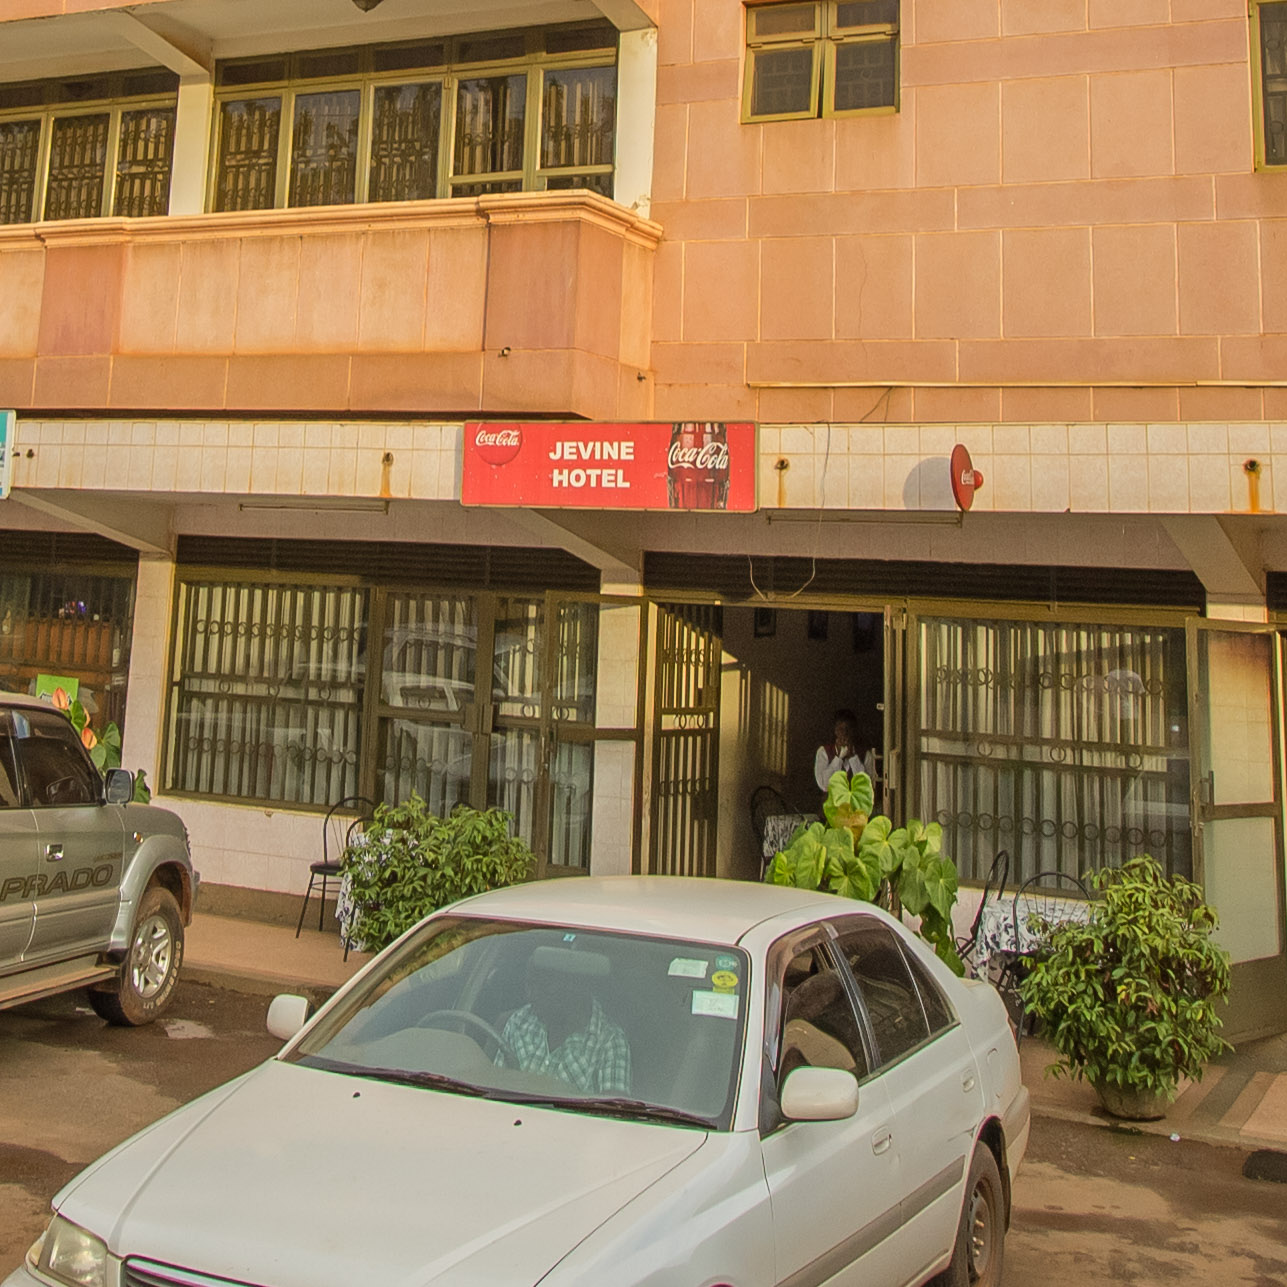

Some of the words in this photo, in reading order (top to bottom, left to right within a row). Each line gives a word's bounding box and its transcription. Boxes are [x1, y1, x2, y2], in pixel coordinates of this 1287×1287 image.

[475, 429, 520, 447] Coca-Cola
[548, 441, 635, 460] JEVINE
[668, 441, 728, 469] Coca-Cola
[552, 468, 631, 488] HOTEL
